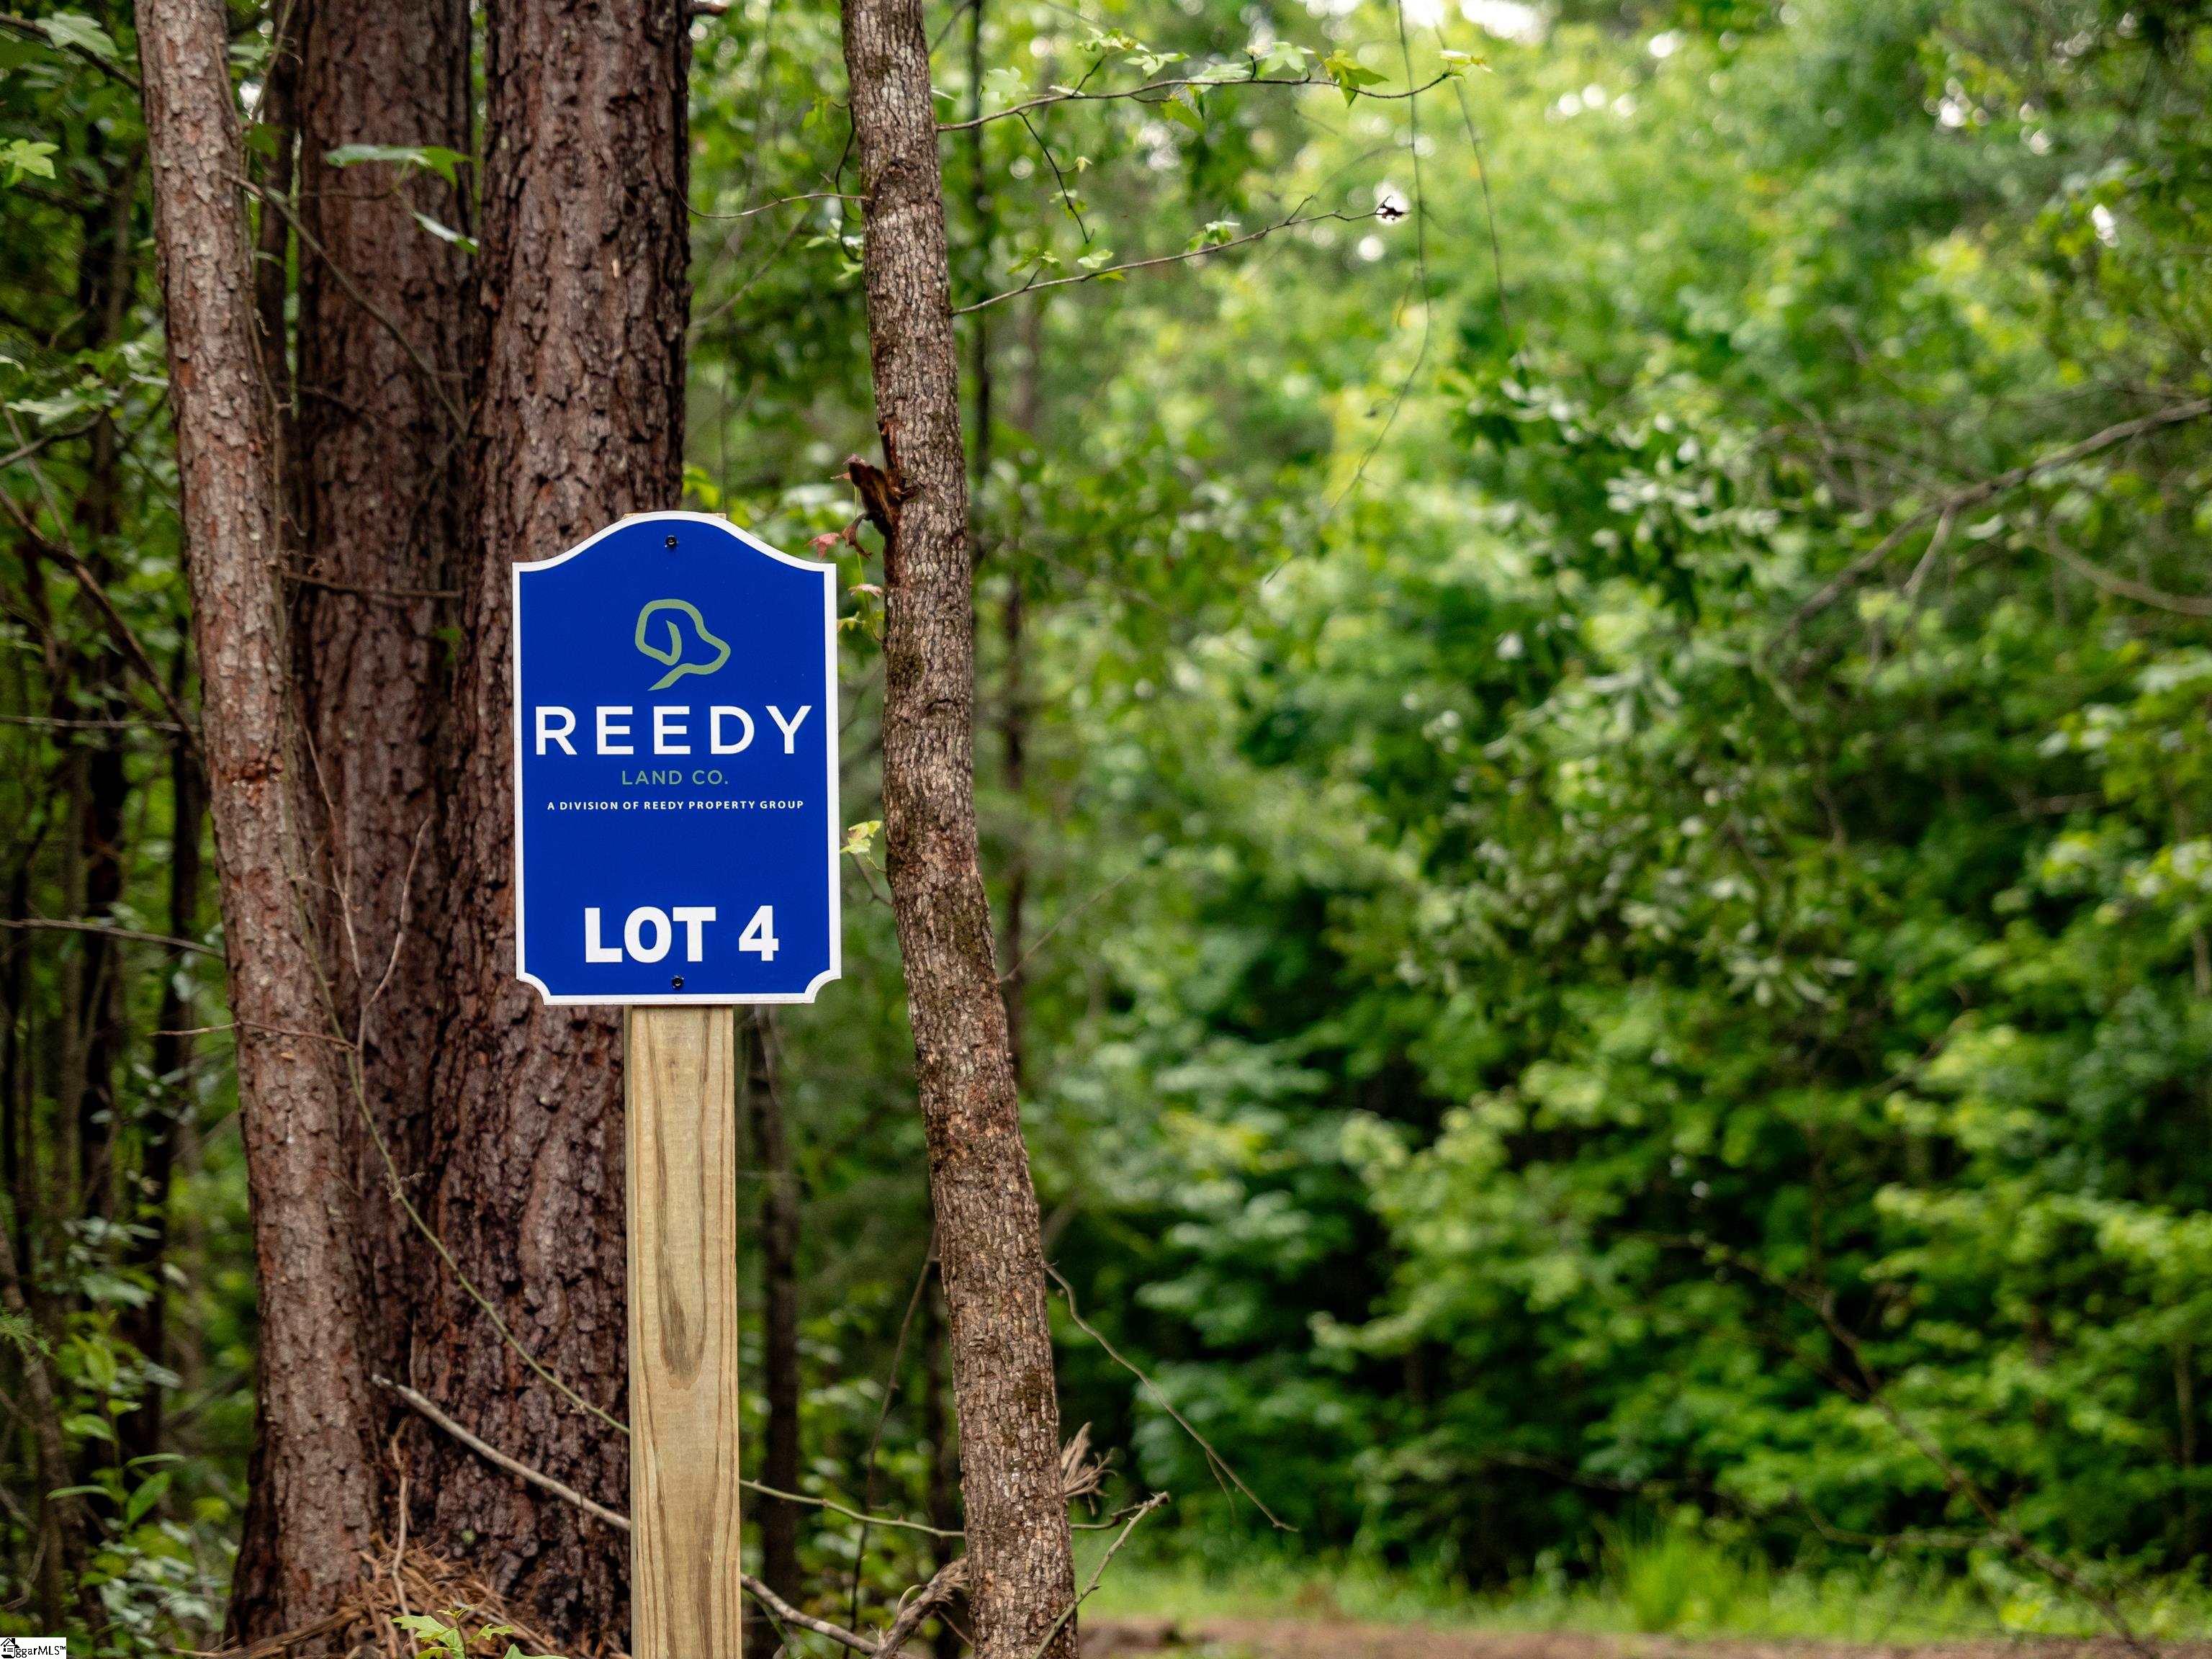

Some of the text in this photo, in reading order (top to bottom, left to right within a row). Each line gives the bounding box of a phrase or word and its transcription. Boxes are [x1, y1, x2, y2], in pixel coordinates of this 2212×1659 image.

[535, 705, 812, 755] REEDY
[621, 769, 729, 786] LAND CO.
[547, 800, 804, 811] A DIVISION OF REEDY PROPERTY GROUP
[585, 905, 779, 963] LOT 4
